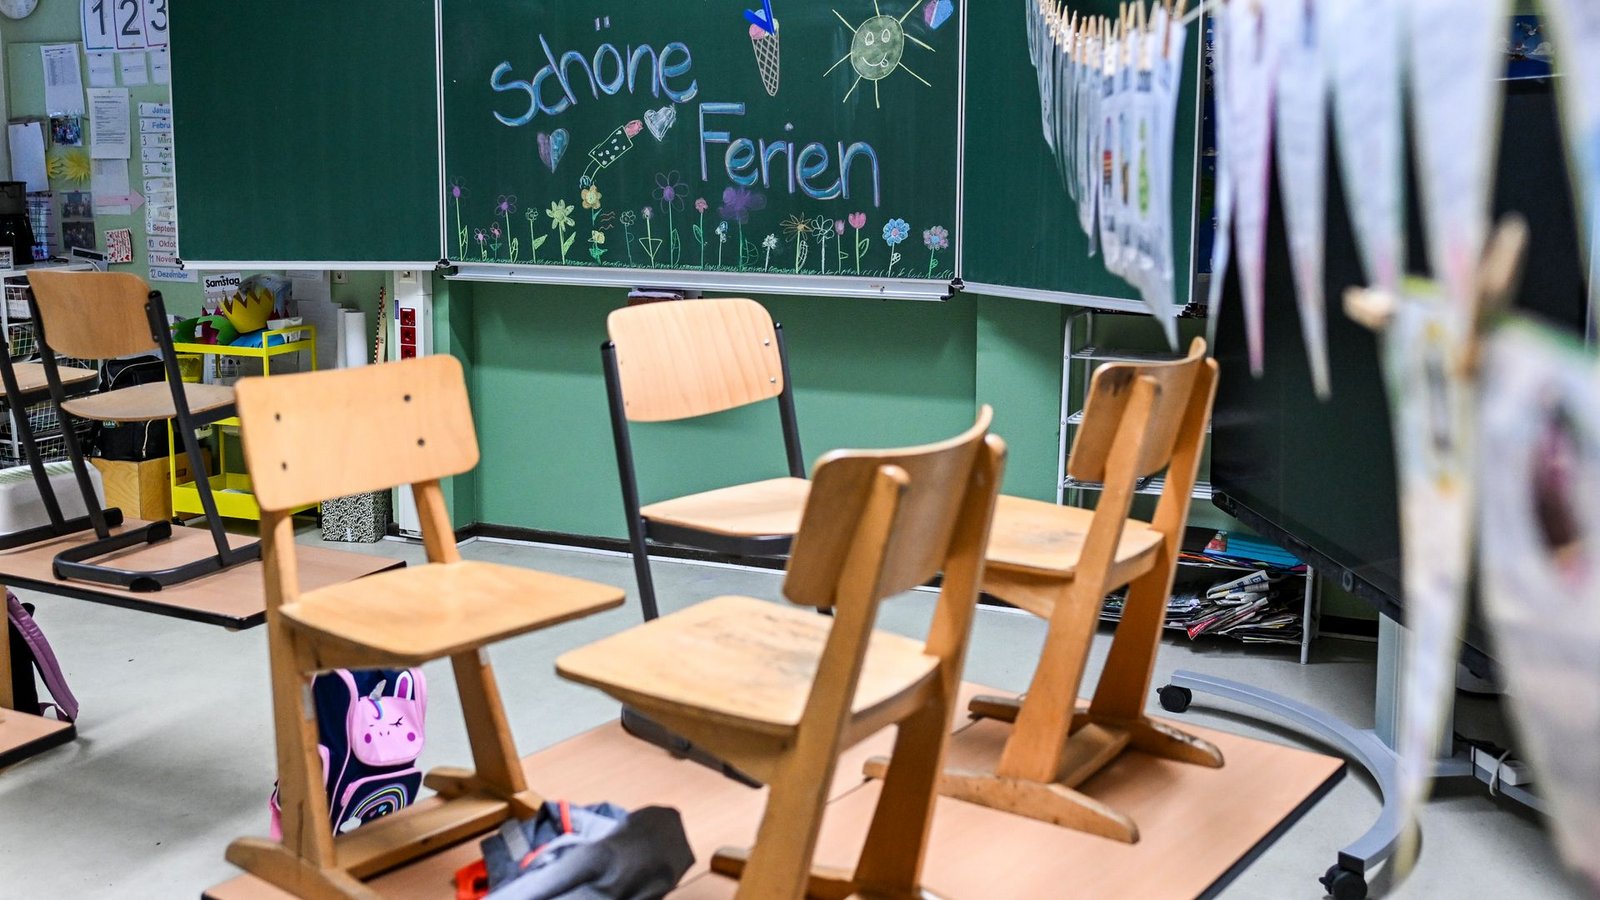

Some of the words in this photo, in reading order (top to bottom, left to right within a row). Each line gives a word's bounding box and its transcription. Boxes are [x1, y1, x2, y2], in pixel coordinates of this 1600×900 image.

[92, 0, 105, 36] 1
[118, 0, 141, 36] 2
[149, 0, 167, 31] 3
[489, 16, 699, 127] Schöne
[699, 102, 880, 208] Ferien
[157, 270, 188, 279] Dezember
[205, 277, 240, 288] Samstag
